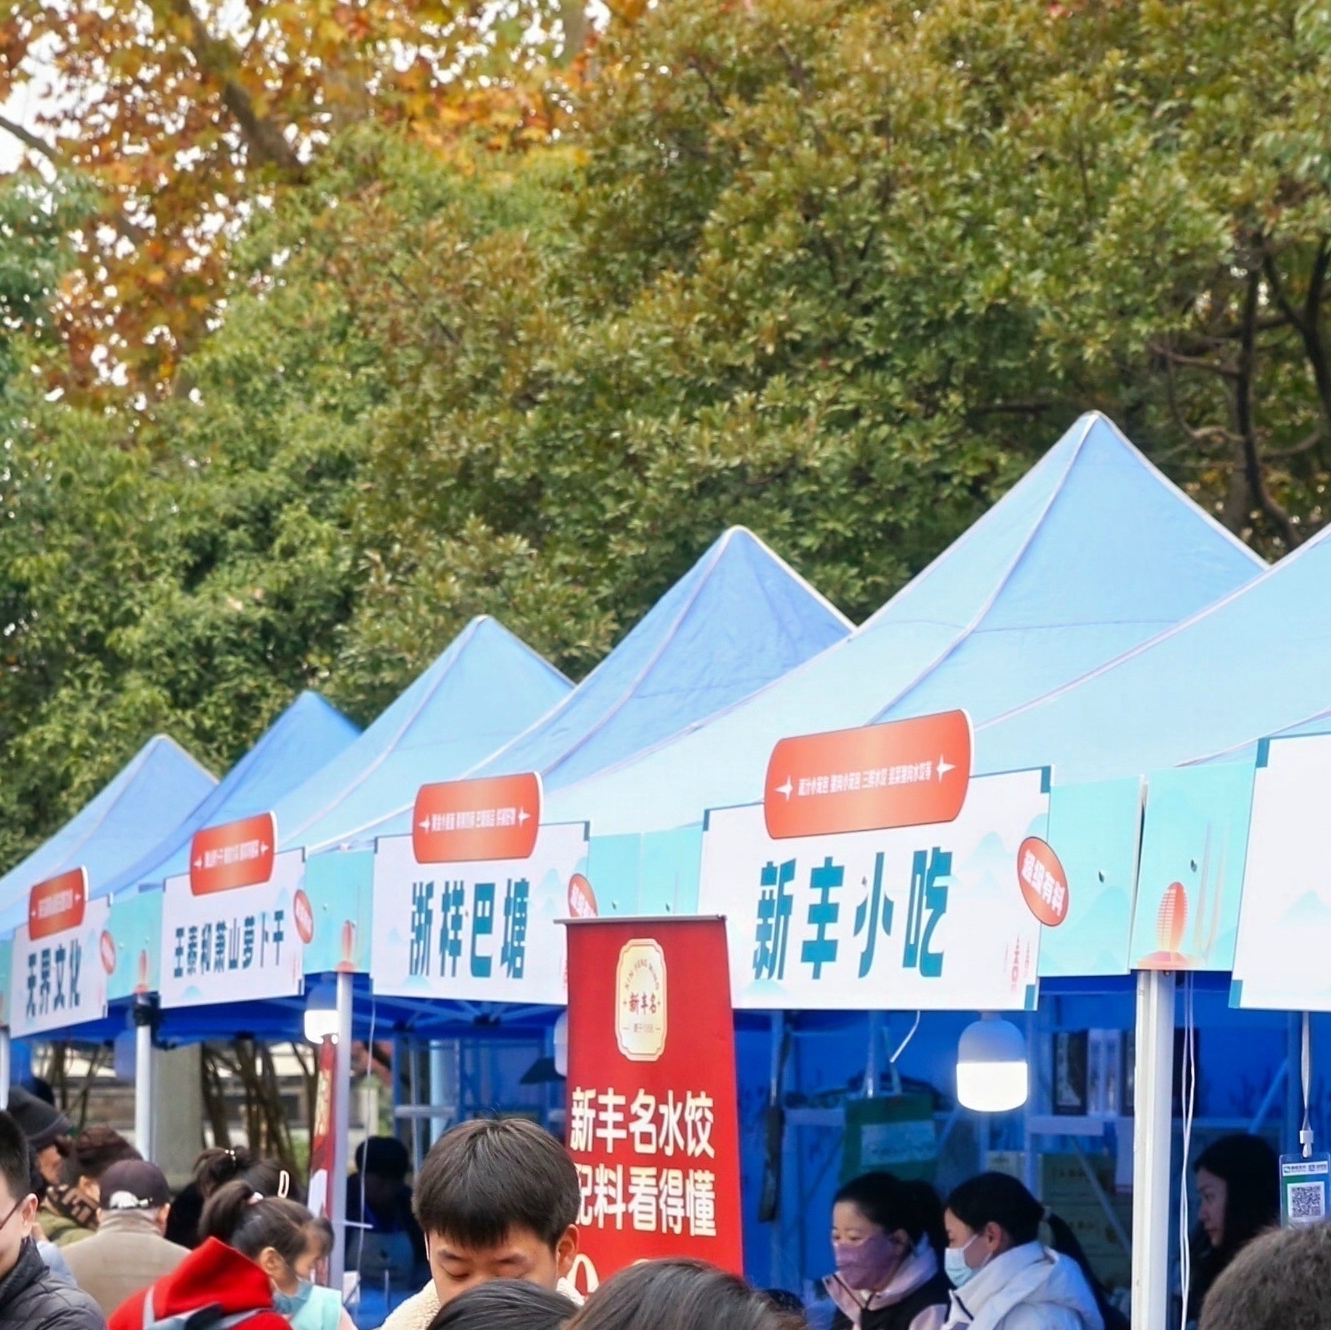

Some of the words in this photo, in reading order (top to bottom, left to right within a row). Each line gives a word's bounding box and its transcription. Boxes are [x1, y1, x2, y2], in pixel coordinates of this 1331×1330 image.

[752, 846, 953, 980] 新丰小吃
[570, 1086, 716, 1159] 新丰名水饺
